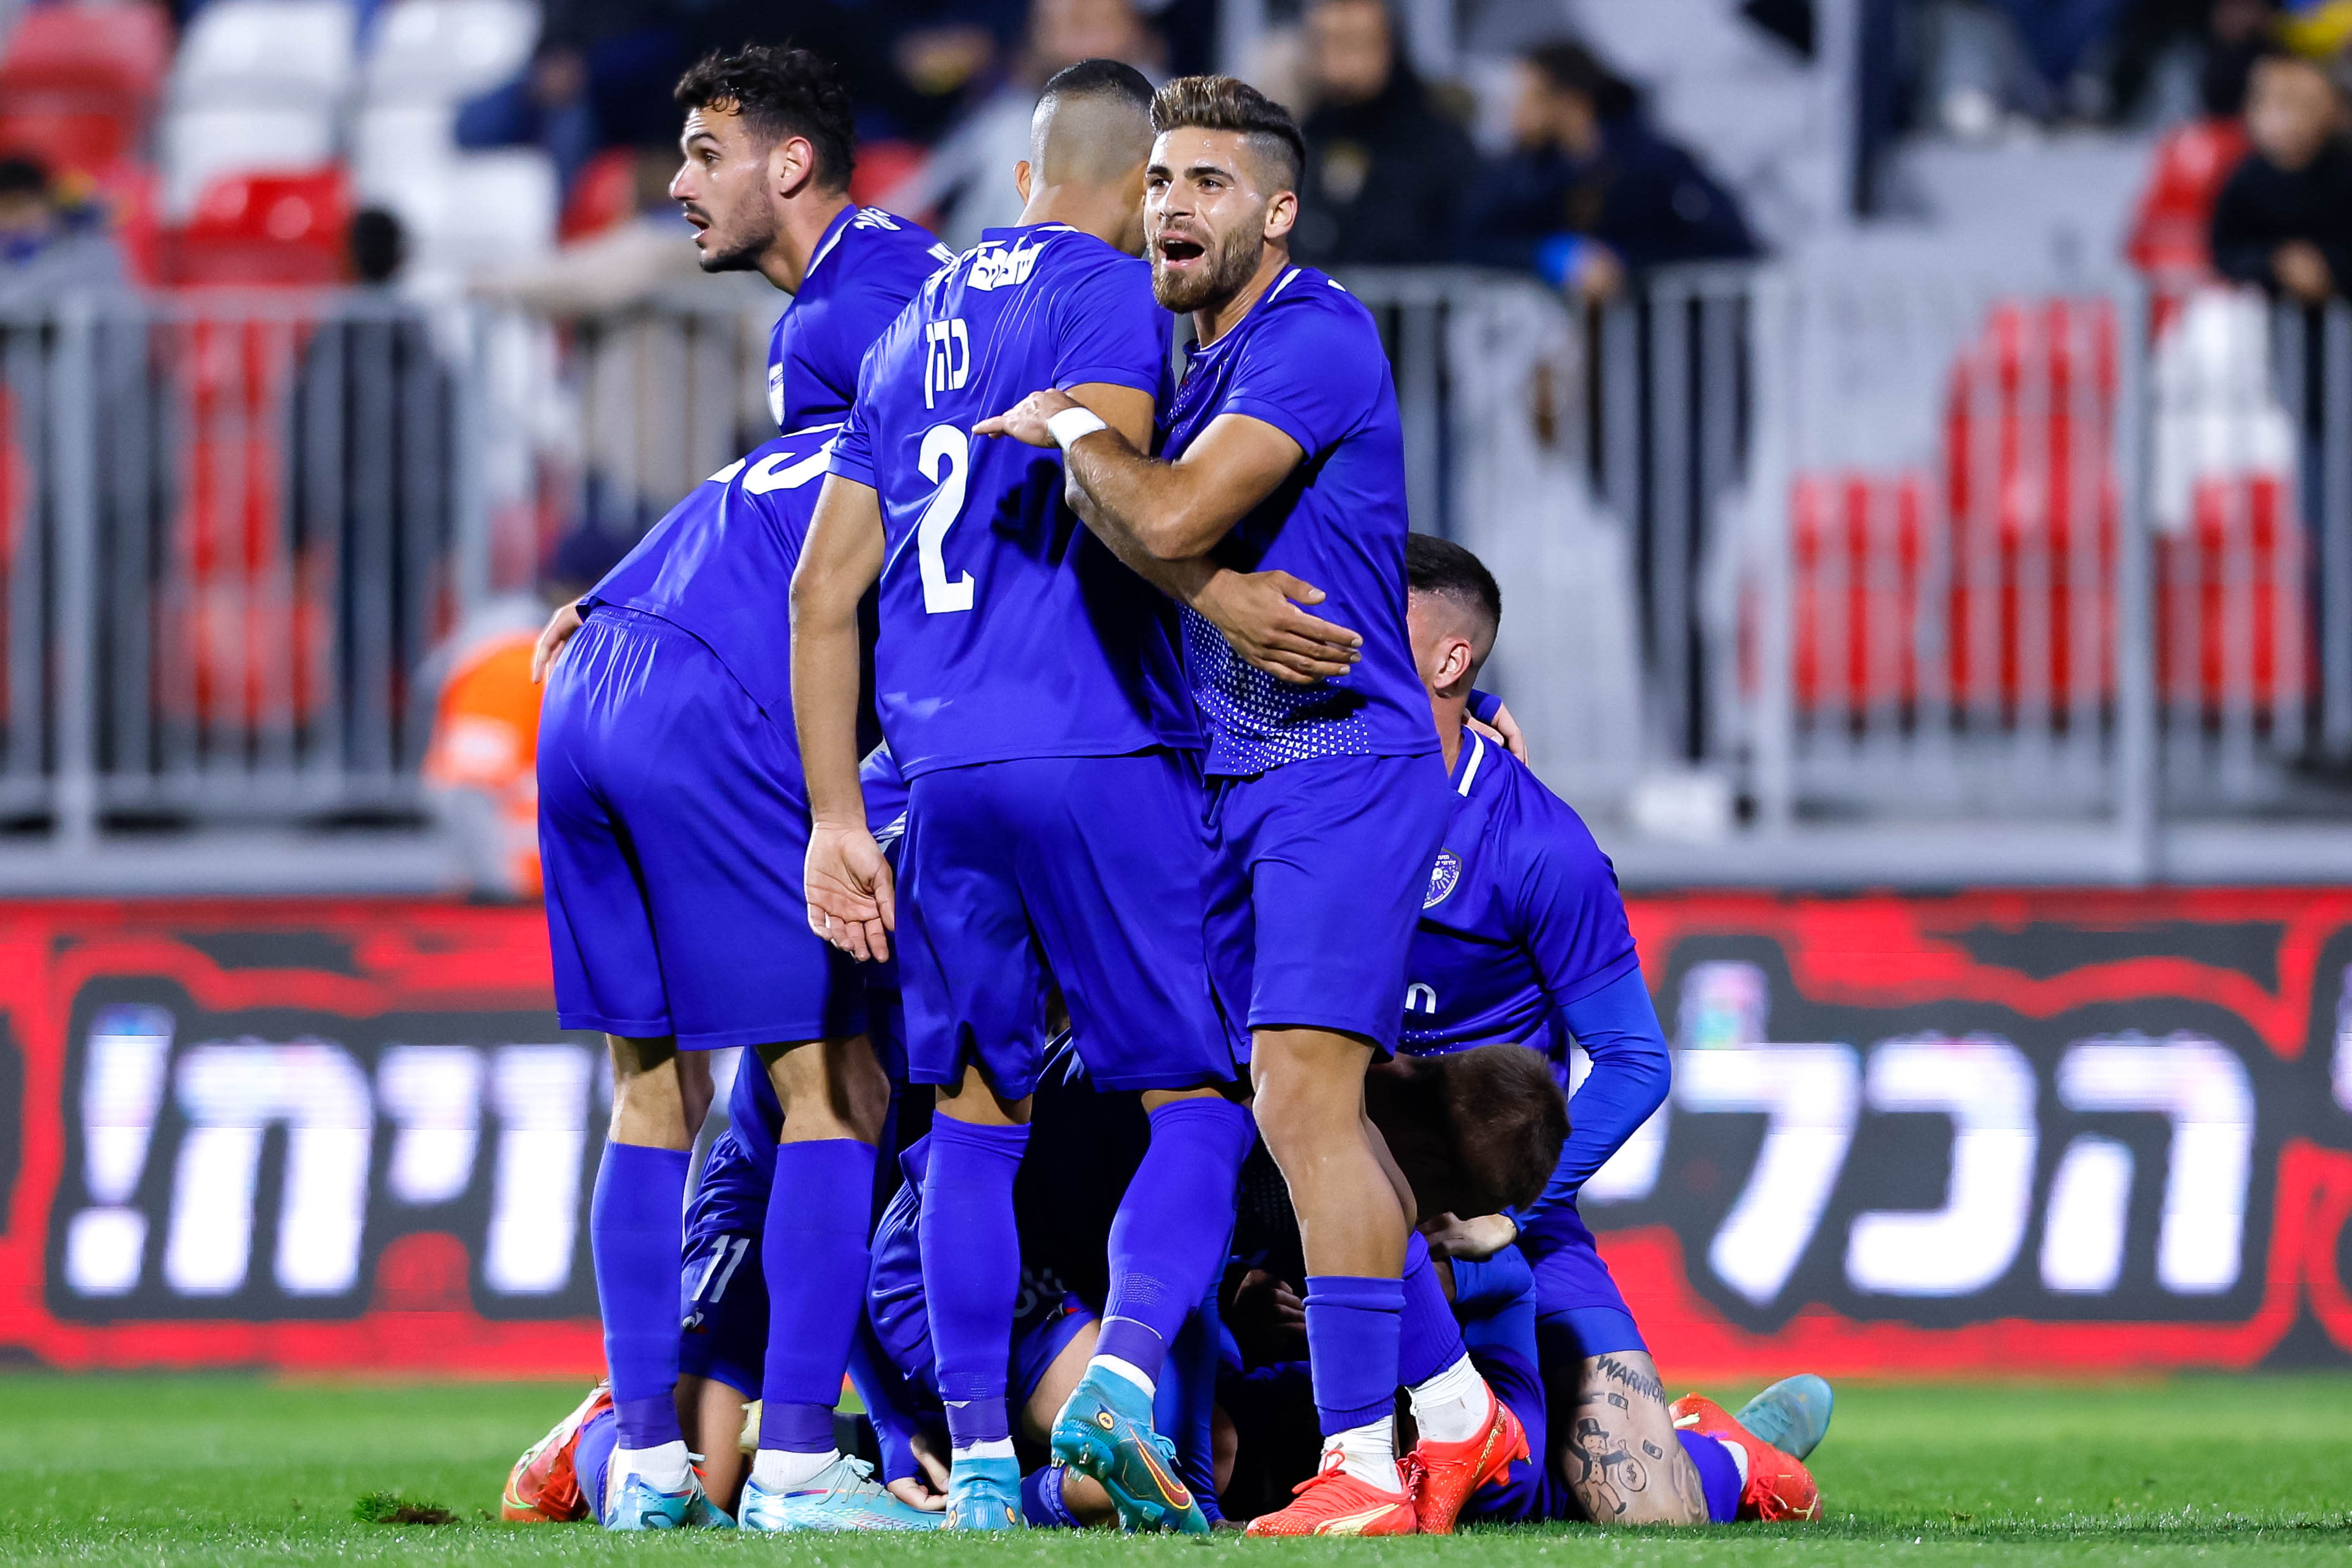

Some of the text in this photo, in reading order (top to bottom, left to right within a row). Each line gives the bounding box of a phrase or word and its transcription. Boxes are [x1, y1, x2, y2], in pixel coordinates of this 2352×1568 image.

[925, 319, 970, 409] כהן
[918, 424, 975, 614] 2
[690, 1234, 750, 1304] 11
[1596, 1354, 1666, 1410] WARRIOR
